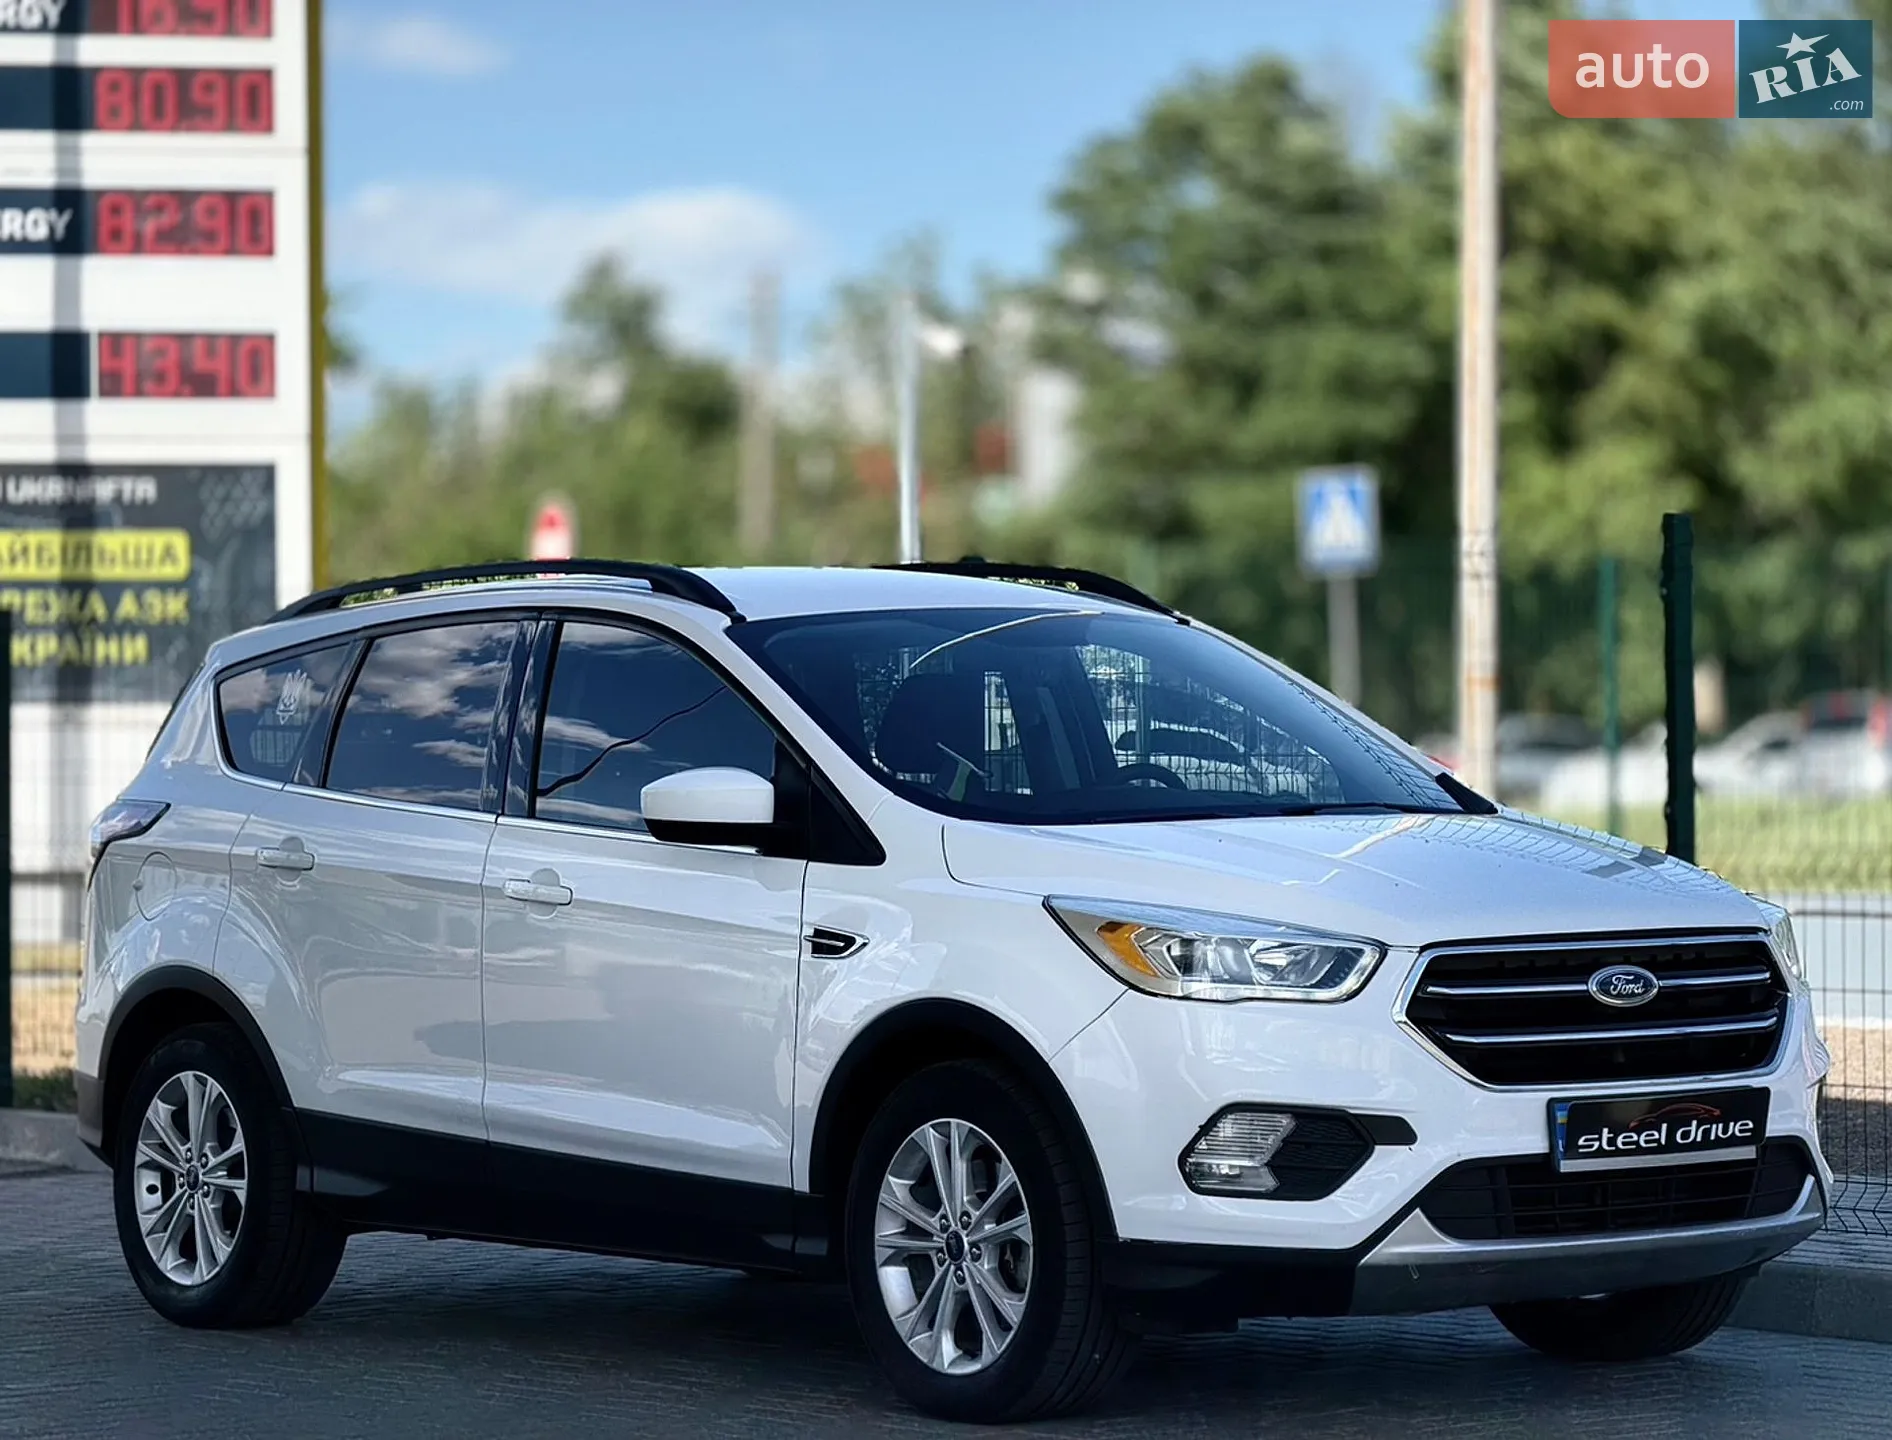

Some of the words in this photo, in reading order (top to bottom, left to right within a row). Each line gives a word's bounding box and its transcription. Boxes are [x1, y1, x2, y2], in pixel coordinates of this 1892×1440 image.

[94, 69, 272, 133] 80.90
[97, 192, 274, 256] 82.90
[100, 335, 275, 398] 43.40
[0, 533, 181, 568] ЙБІЛЬША
[1609, 974, 1646, 996] Ford
[1577, 1123, 1668, 1152] steel
[1675, 1119, 1754, 1145] drive
